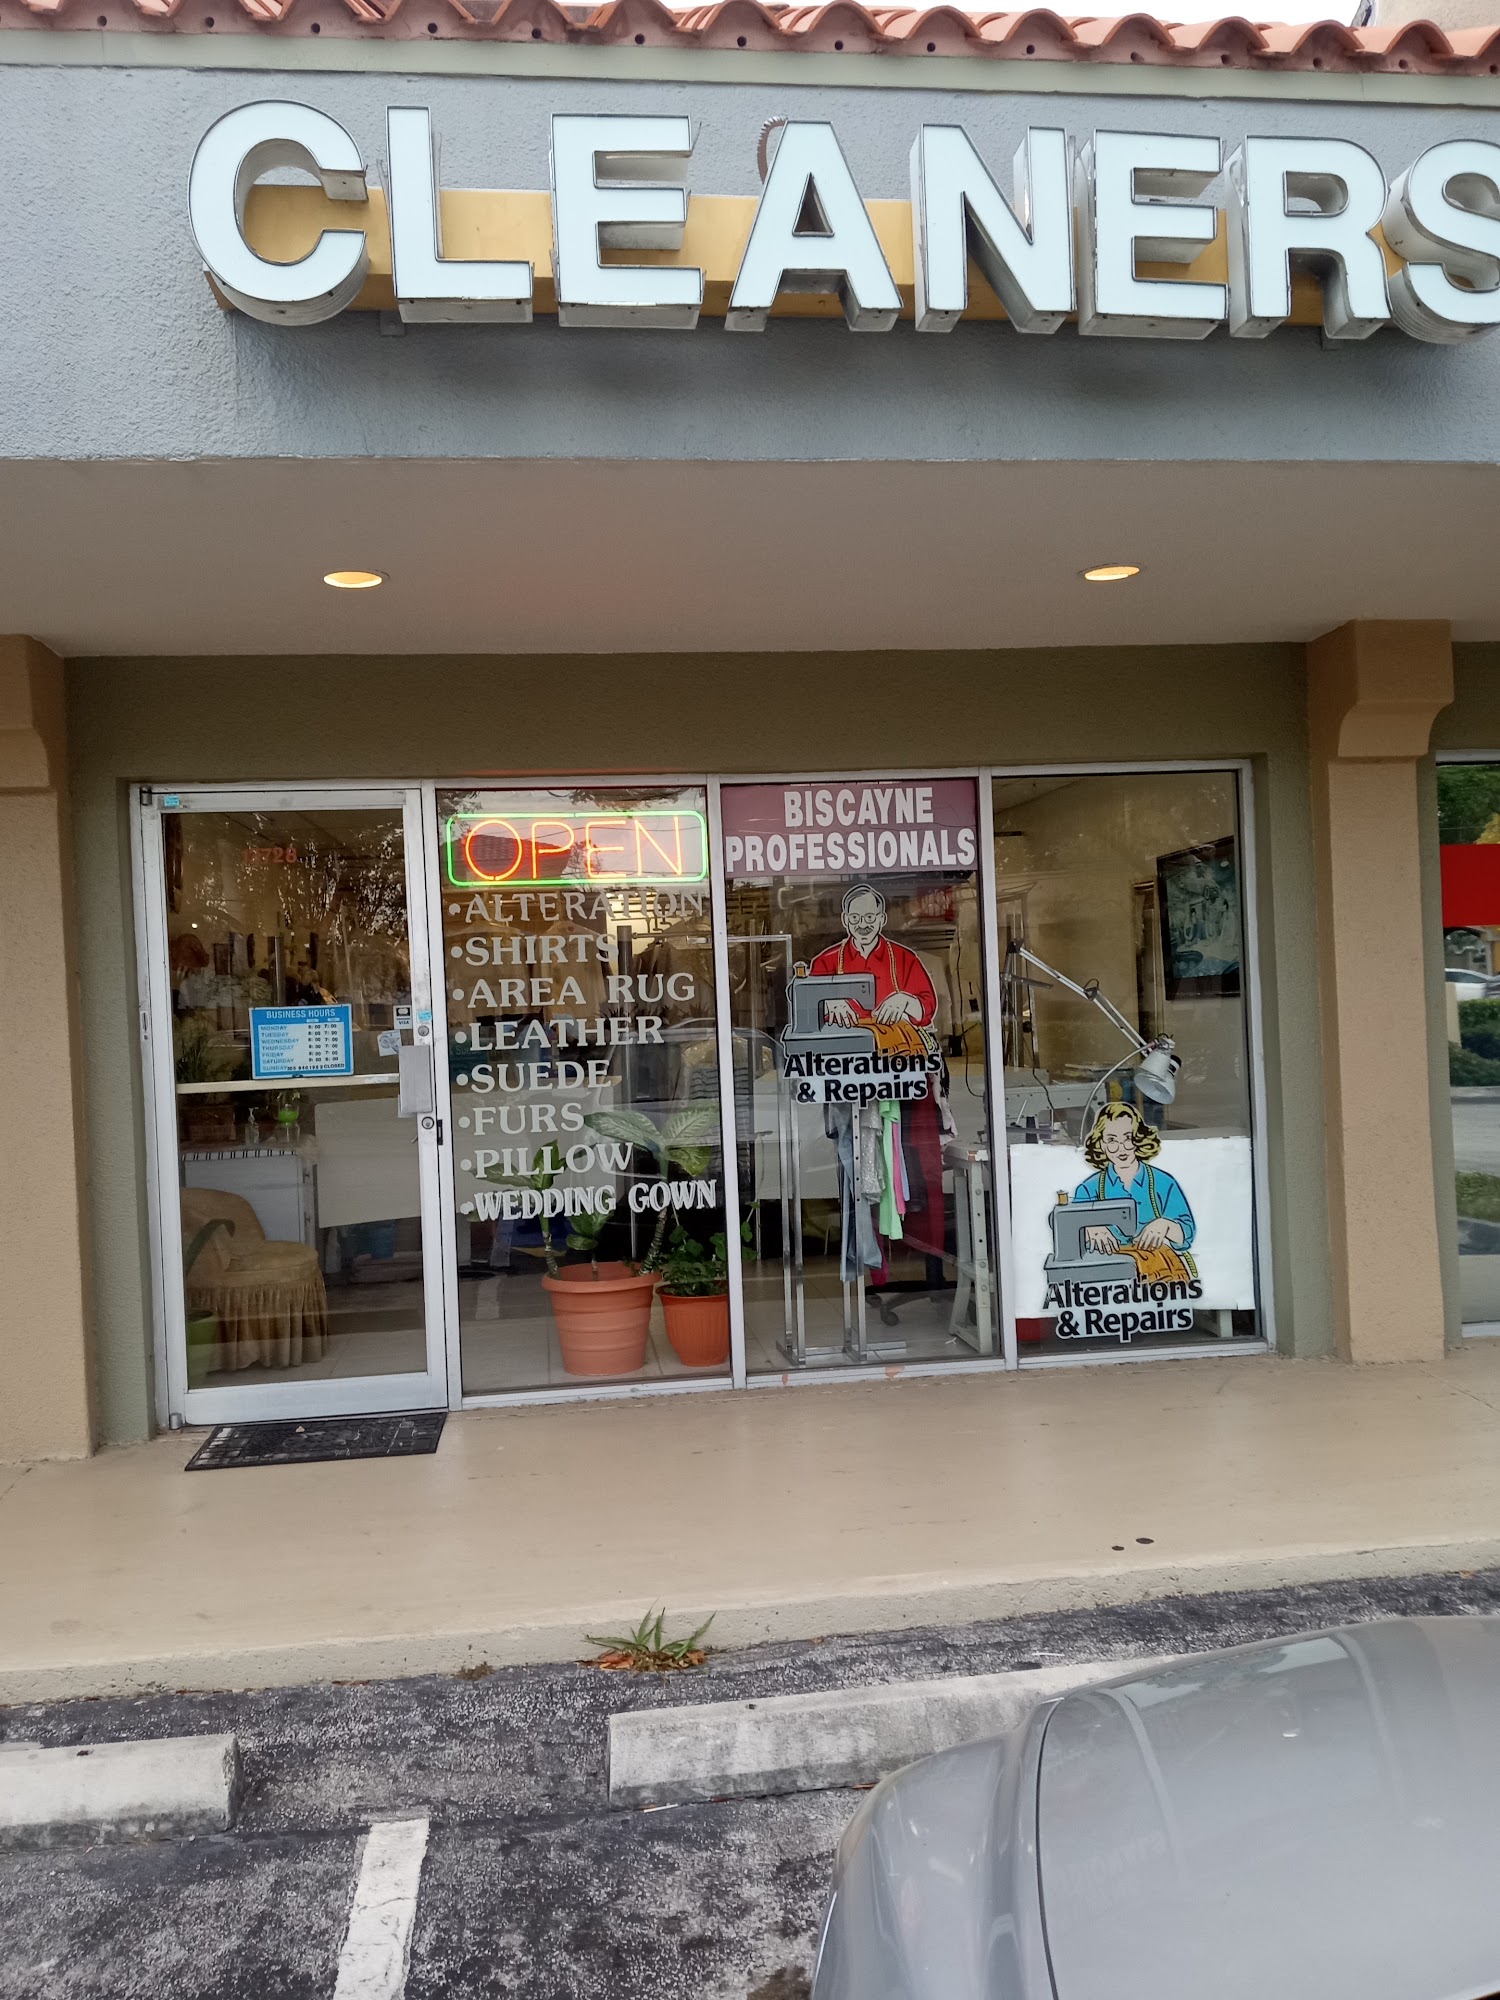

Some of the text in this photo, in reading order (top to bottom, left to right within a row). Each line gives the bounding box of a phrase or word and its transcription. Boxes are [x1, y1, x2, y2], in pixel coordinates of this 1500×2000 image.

[188, 99, 1500, 325] CLEANERS
[784, 787, 934, 828] BISCAYNE
[465, 816, 683, 881] OPEN
[725, 828, 975, 873] PROFESSIONALS
[465, 889, 704, 923] ALTERATION
[465, 933, 619, 966] SHIRTS
[467, 972, 695, 1009] AREA RUG
[266, 1008, 336, 1019] BUSINESS HOURS
[469, 1015, 665, 1051] LEATHER
[470, 1059, 612, 1094] SUEDE
[784, 1049, 941, 1077] Alterations
[797, 1074, 927, 1107] & Repairs
[473, 1102, 585, 1136] FURS
[474, 1142, 634, 1179] PILLOW
[474, 1179, 717, 1222] WEDDING GOWN
[1043, 1274, 1203, 1310] Alterations
[1058, 1302, 1192, 1341] & Repairs
